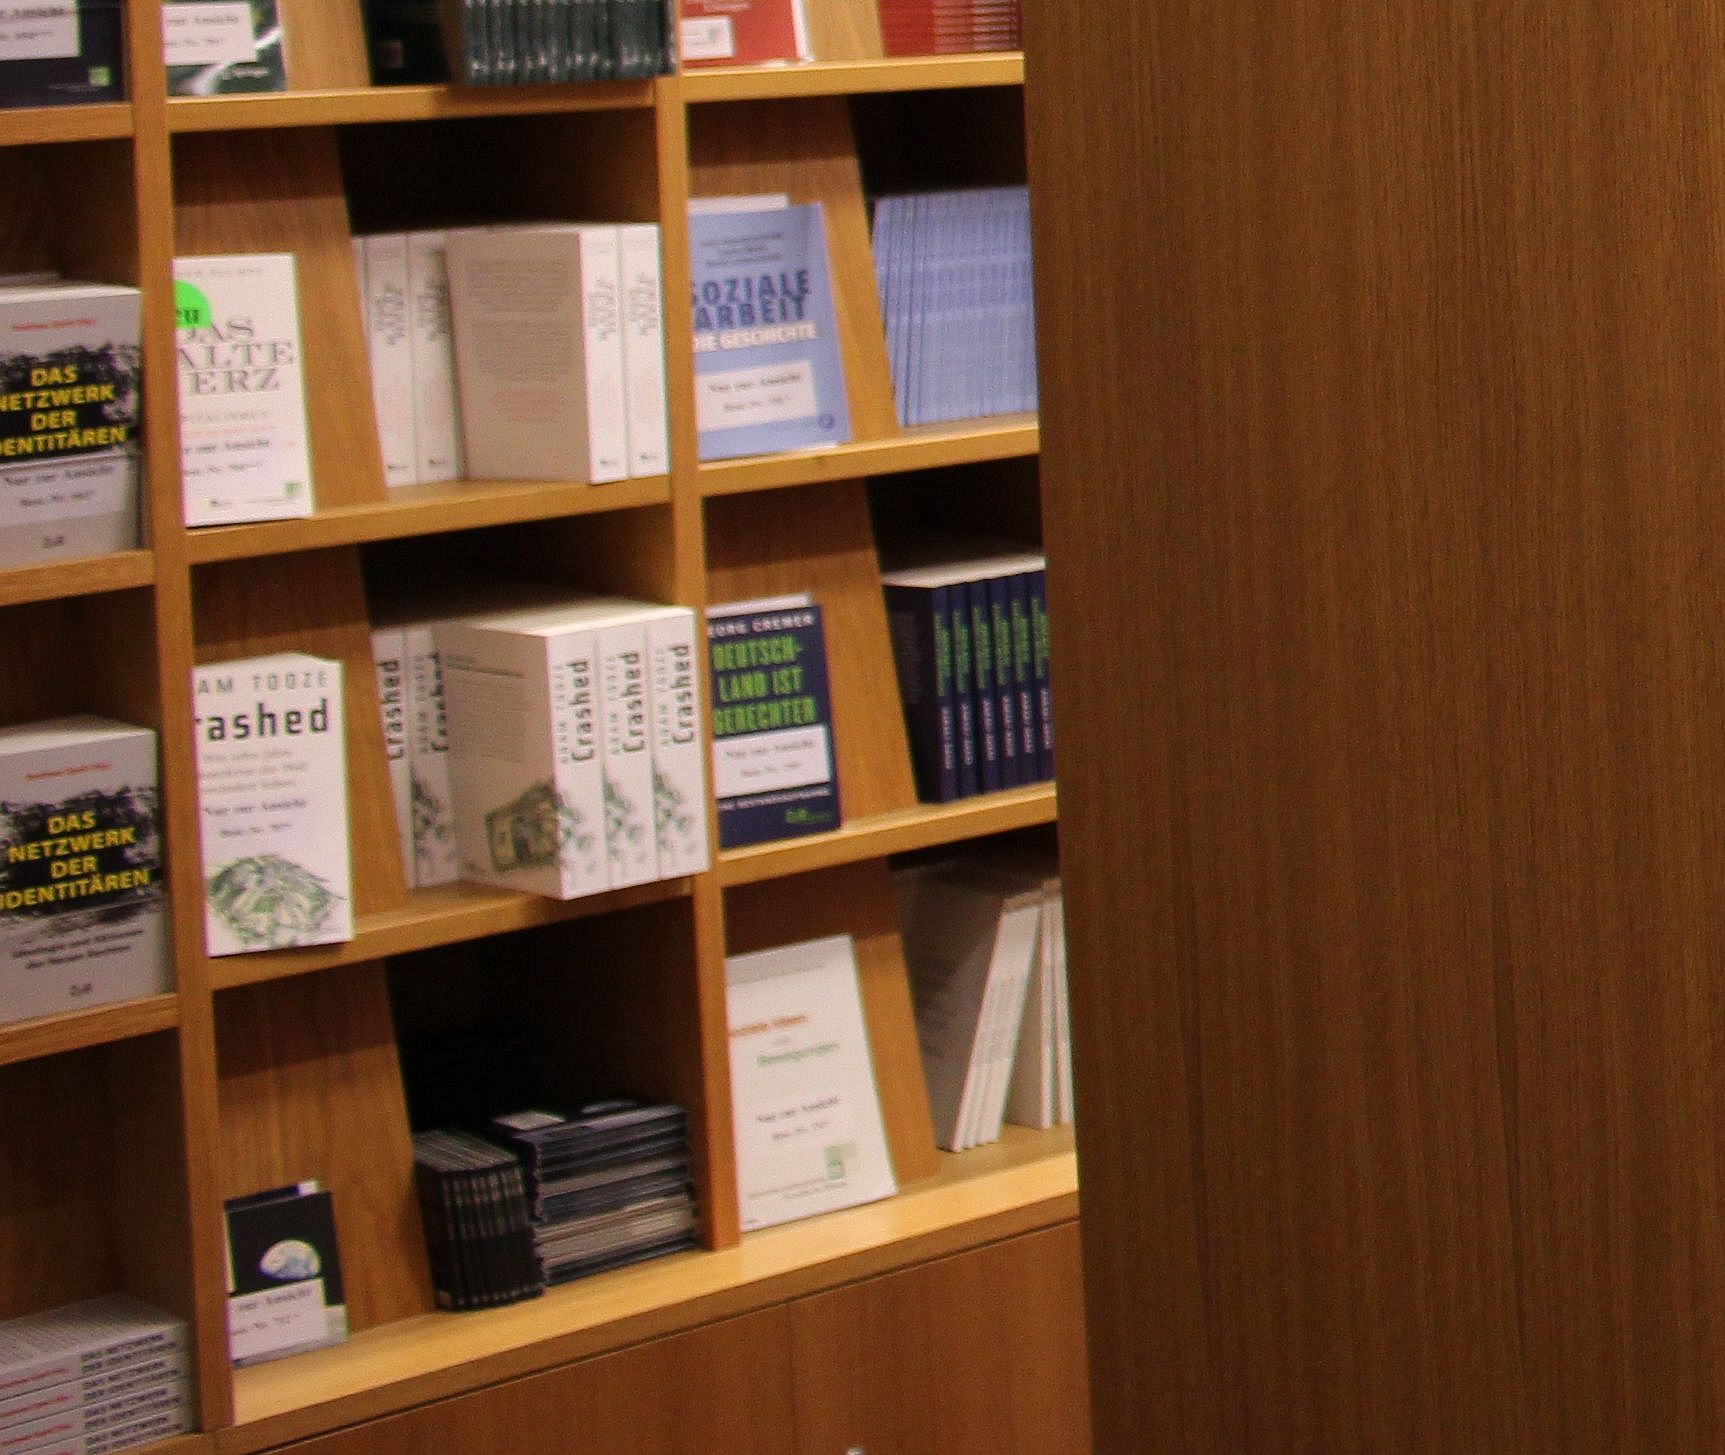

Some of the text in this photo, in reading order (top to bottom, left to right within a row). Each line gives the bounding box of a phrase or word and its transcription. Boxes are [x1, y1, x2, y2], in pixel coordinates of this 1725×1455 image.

[696, 297, 806, 330] ARBEIT
[30, 364, 79, 387] DAS
[30, 409, 77, 432] DER
[571, 659, 594, 762] Crashed
[623, 651, 645, 753] Crashed
[672, 643, 695, 746] Crashed
[47, 811, 97, 835] DAS
[7, 827, 137, 863] NETZWERK
[50, 855, 99, 880] DER
